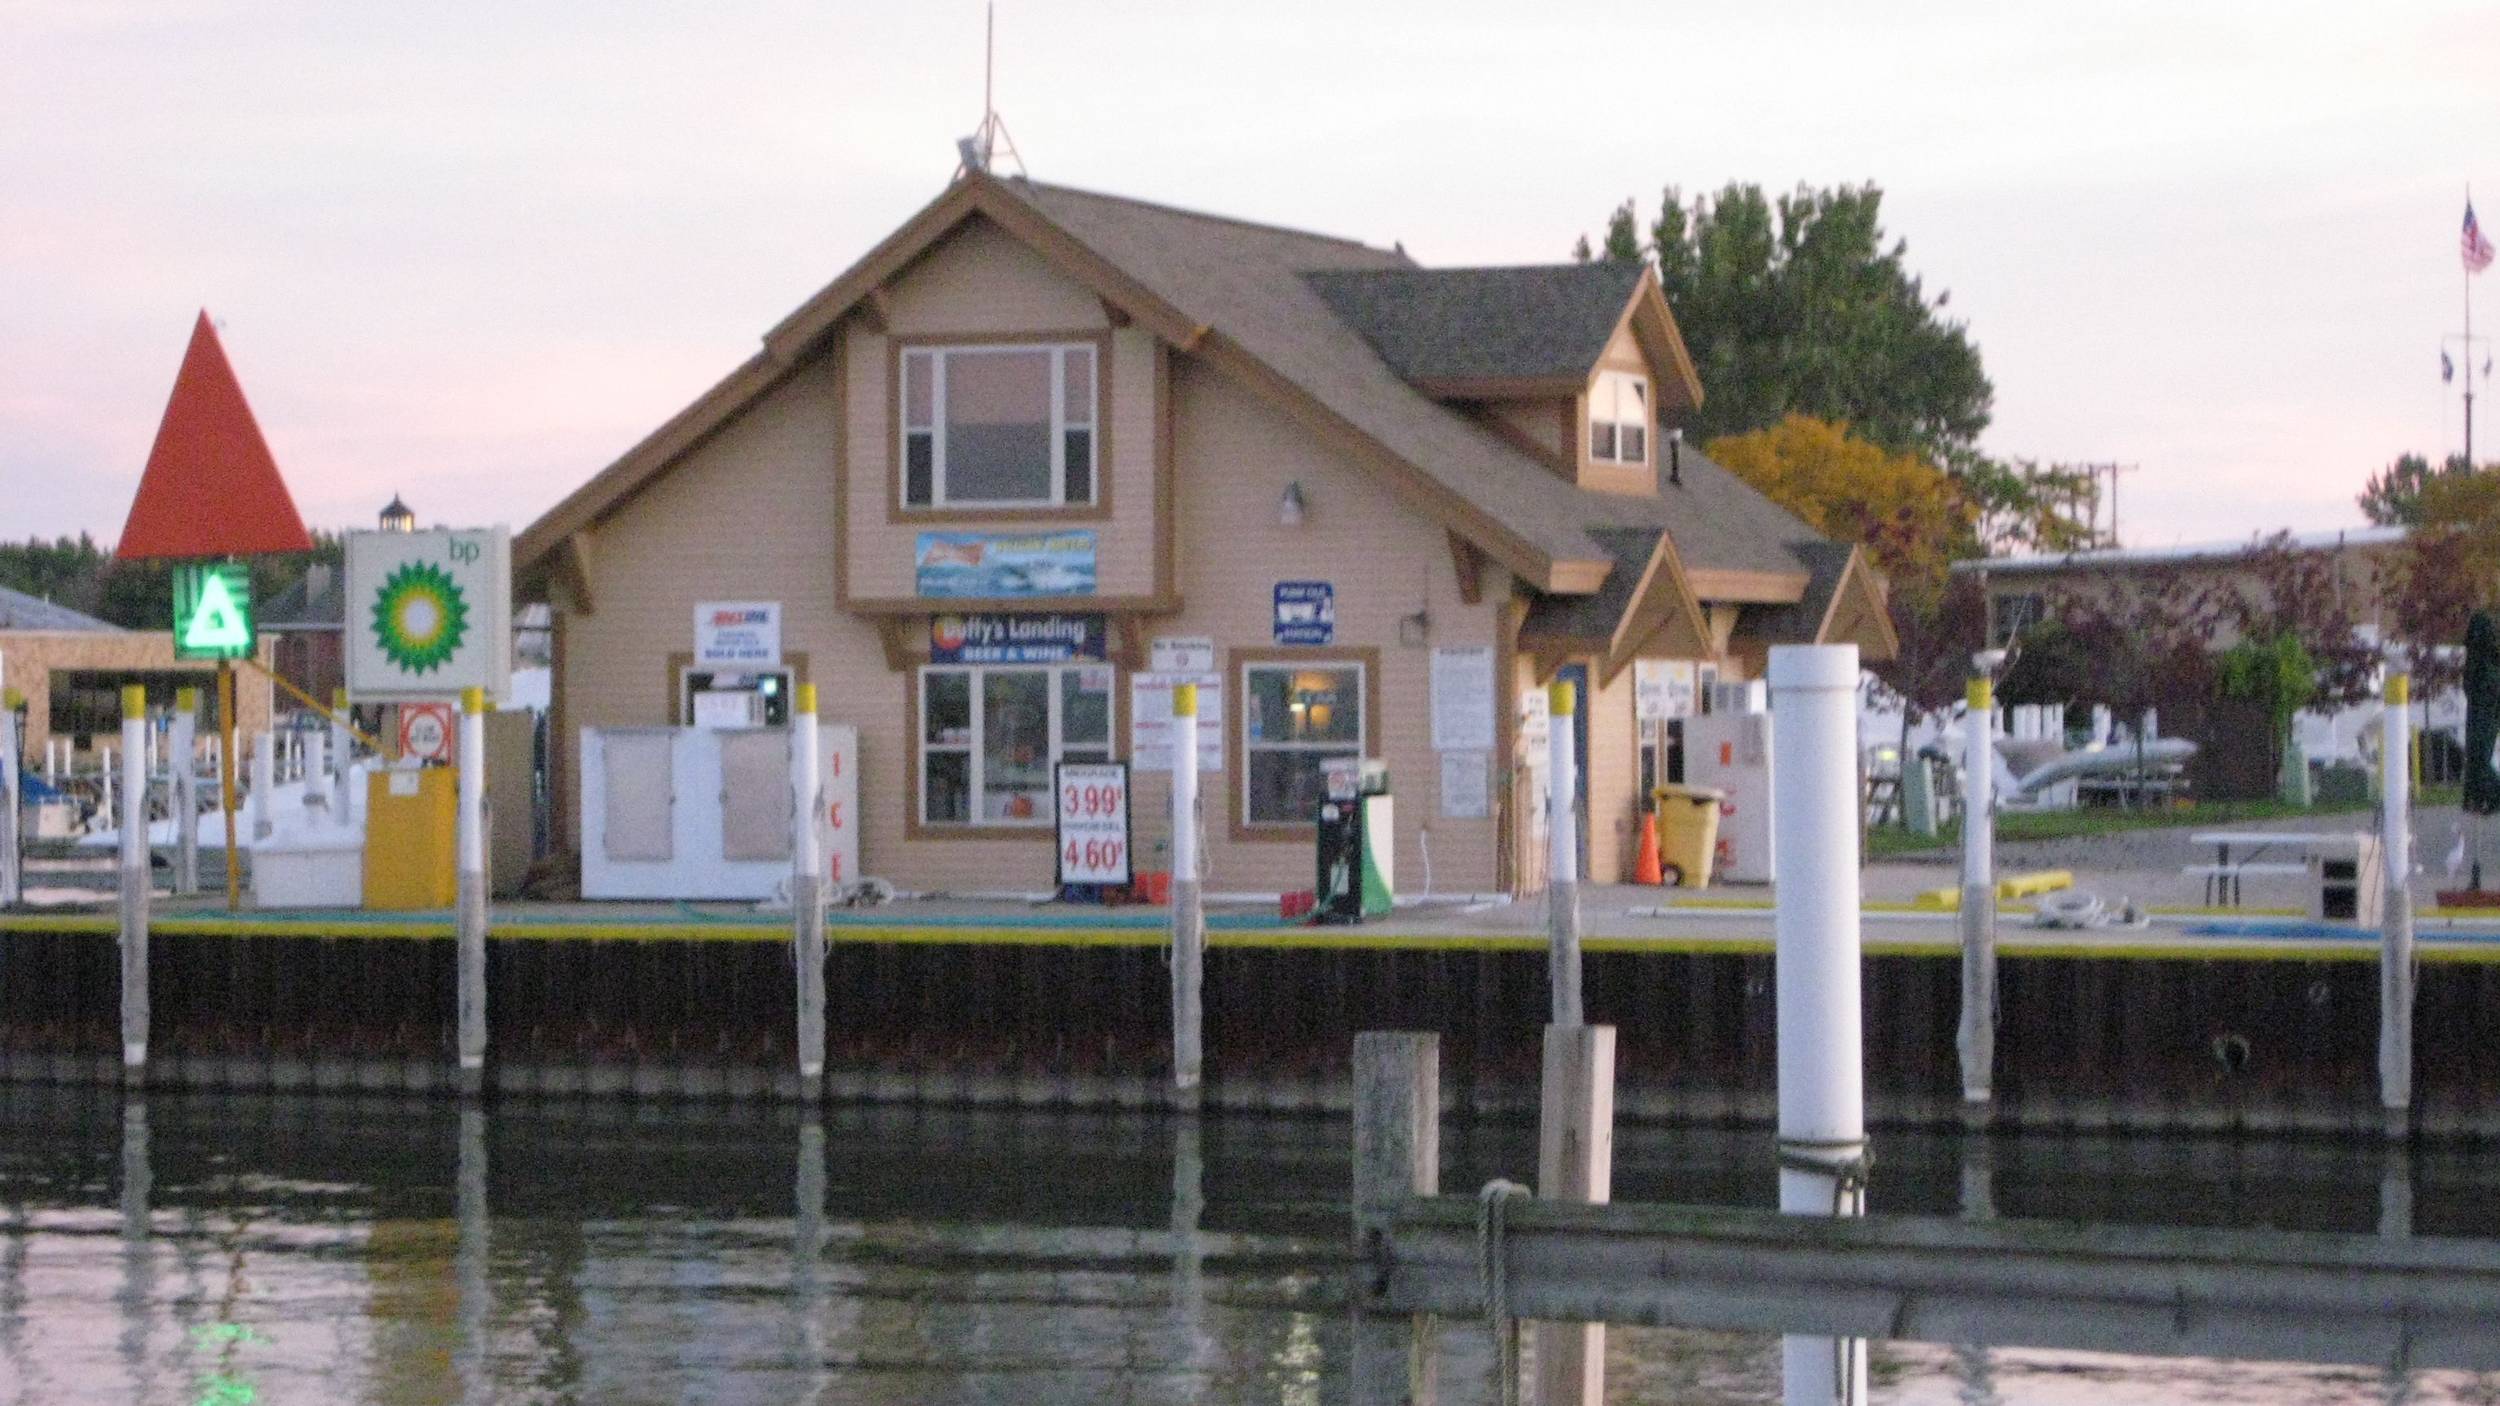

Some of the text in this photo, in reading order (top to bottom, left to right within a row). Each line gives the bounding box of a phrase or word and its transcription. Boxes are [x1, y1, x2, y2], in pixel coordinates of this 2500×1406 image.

[449, 536, 480, 565] bp
[1008, 615, 1086, 645] Landing
[964, 646, 1002, 661] BEER
[1022, 646, 1065, 661] WINE
